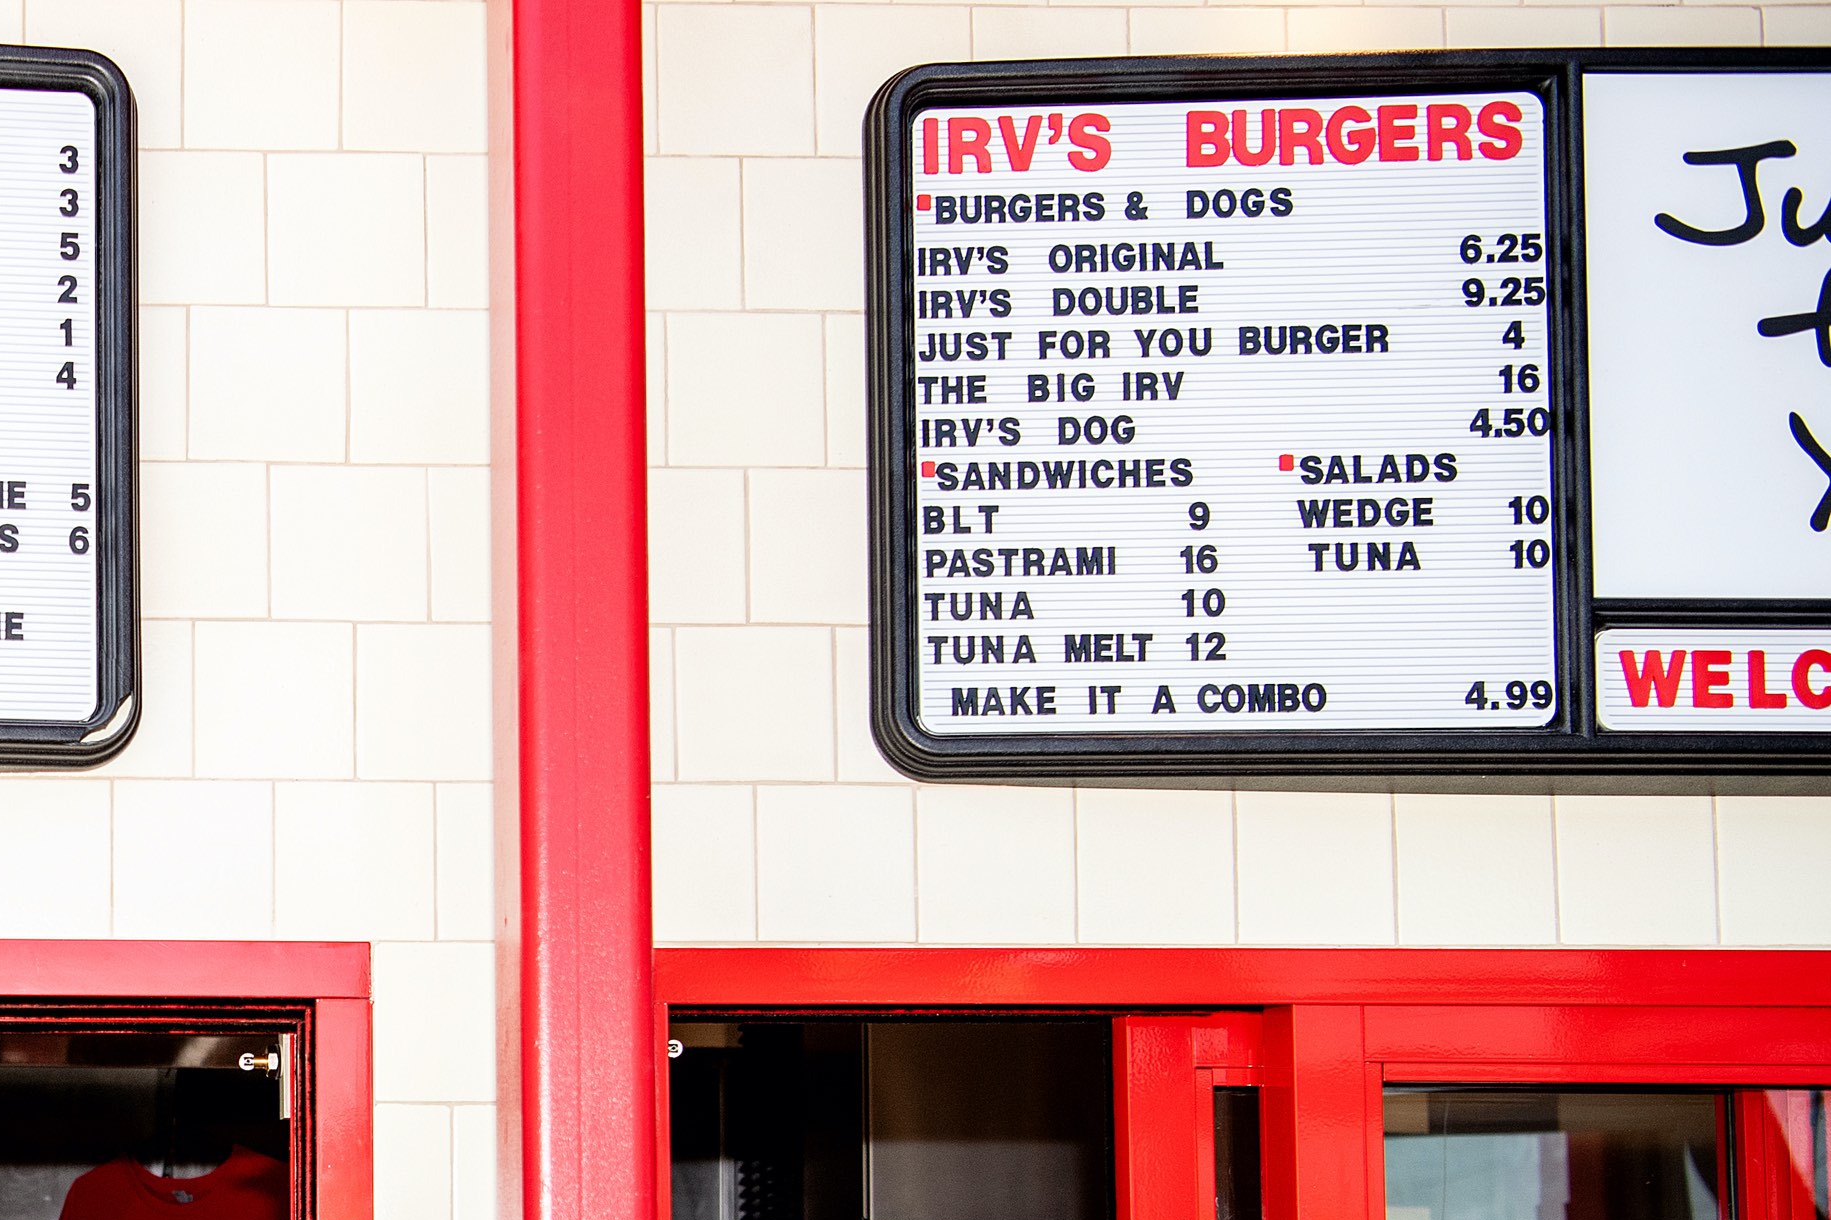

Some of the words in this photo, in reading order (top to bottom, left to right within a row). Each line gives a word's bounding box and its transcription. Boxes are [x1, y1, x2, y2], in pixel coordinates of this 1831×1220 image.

[923, 113, 1111, 175] IRV'S
[1186, 101, 1522, 168] BURGERS
[59, 146, 78, 173] 3
[59, 189, 79, 217] 3
[936, 192, 1105, 224] BURGERS
[1125, 191, 1148, 220] &
[1187, 188, 1293, 219] DOGS
[61, 233, 80, 260] 5
[918, 246, 1008, 276] IRV'S
[1049, 242, 1223, 273] ORIGINAL
[1460, 234, 1542, 264] 6.25
[58, 275, 77, 303] 2
[919, 289, 1011, 319] IRV'S
[1053, 285, 1198, 316] DOUBLE
[1462, 277, 1545, 307] 9.25
[60, 319, 72, 346] 1
[919, 332, 1012, 361] JUST
[1039, 330, 1110, 359] FOR
[1134, 328, 1211, 357] YOU
[1239, 324, 1388, 355] BURGER
[1502, 321, 1525, 349] 4
[56, 362, 76, 389] 4
[918, 375, 986, 404] THE
[1028, 373, 1095, 402] BIG
[1123, 372, 1184, 400] IRV
[1499, 364, 1540, 393] 16
[922, 417, 1020, 447] IRV'S
[1058, 415, 1135, 445] DOG
[1469, 408, 1552, 438] 4.50
[935, 458, 1193, 491] SANDWICHES
[1300, 453, 1457, 485] SALADS
[71, 484, 91, 511] 5
[1296, 498, 1433, 528] WEDGE
[1508, 495, 1549, 525] 10
[923, 505, 999, 534] BLT
[1189, 502, 1210, 530] 9
[70, 526, 89, 554] 6
[1308, 542, 1421, 572] TUNA
[1510, 539, 1550, 569] 10
[926, 547, 1115, 578] PASTRAMI
[1180, 545, 1218, 573] 16
[924, 592, 1034, 621] TUNA
[1182, 588, 1225, 617] 10
[928, 635, 1036, 665] TUNA
[1064, 634, 1153, 663] MELT
[1186, 632, 1226, 661] 12
[952, 687, 1056, 716] MAKE
[1089, 686, 1121, 714] IT
[1152, 685, 1176, 714] A
[1197, 683, 1326, 713] COMBO
[1465, 680, 1552, 710] 4.99
